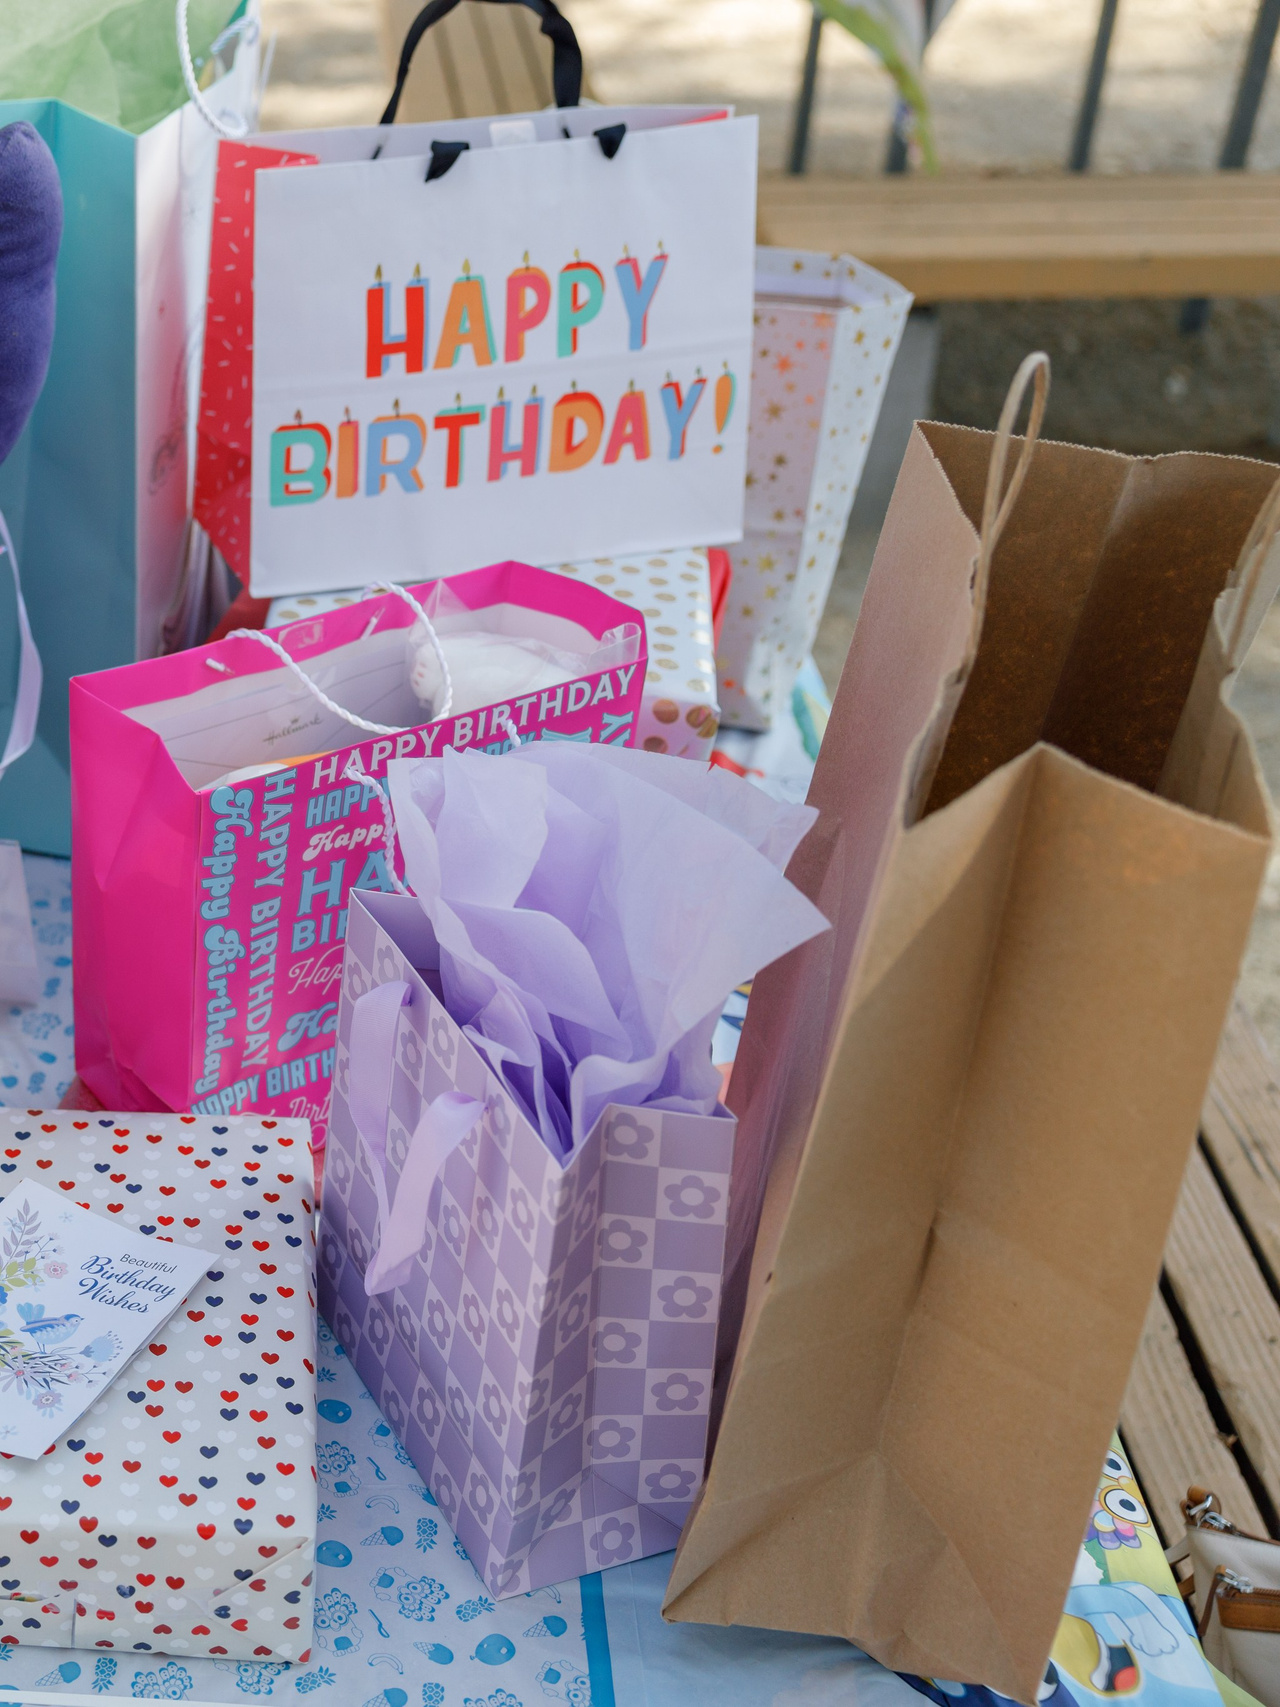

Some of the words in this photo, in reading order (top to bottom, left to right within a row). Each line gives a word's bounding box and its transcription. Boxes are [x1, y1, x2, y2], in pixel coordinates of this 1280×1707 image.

[366, 250, 669, 379] HAPPY
[270, 370, 736, 508] BIRTHDAY!
[312, 724, 442, 790] HAPPY
[452, 664, 637, 748] BIRTHDAY
[200, 786, 254, 920] Happy
[255, 768, 297, 888] HAPPY
[195, 924, 246, 1095] Birthday
[241, 896, 281, 1069] BIRTHDAY
[266, 1047, 337, 1098] BIRTH
[78, 1277, 149, 1313] Wishes
[80, 1255, 176, 1303] Birthday
[119, 1253, 178, 1274] Beautiful
